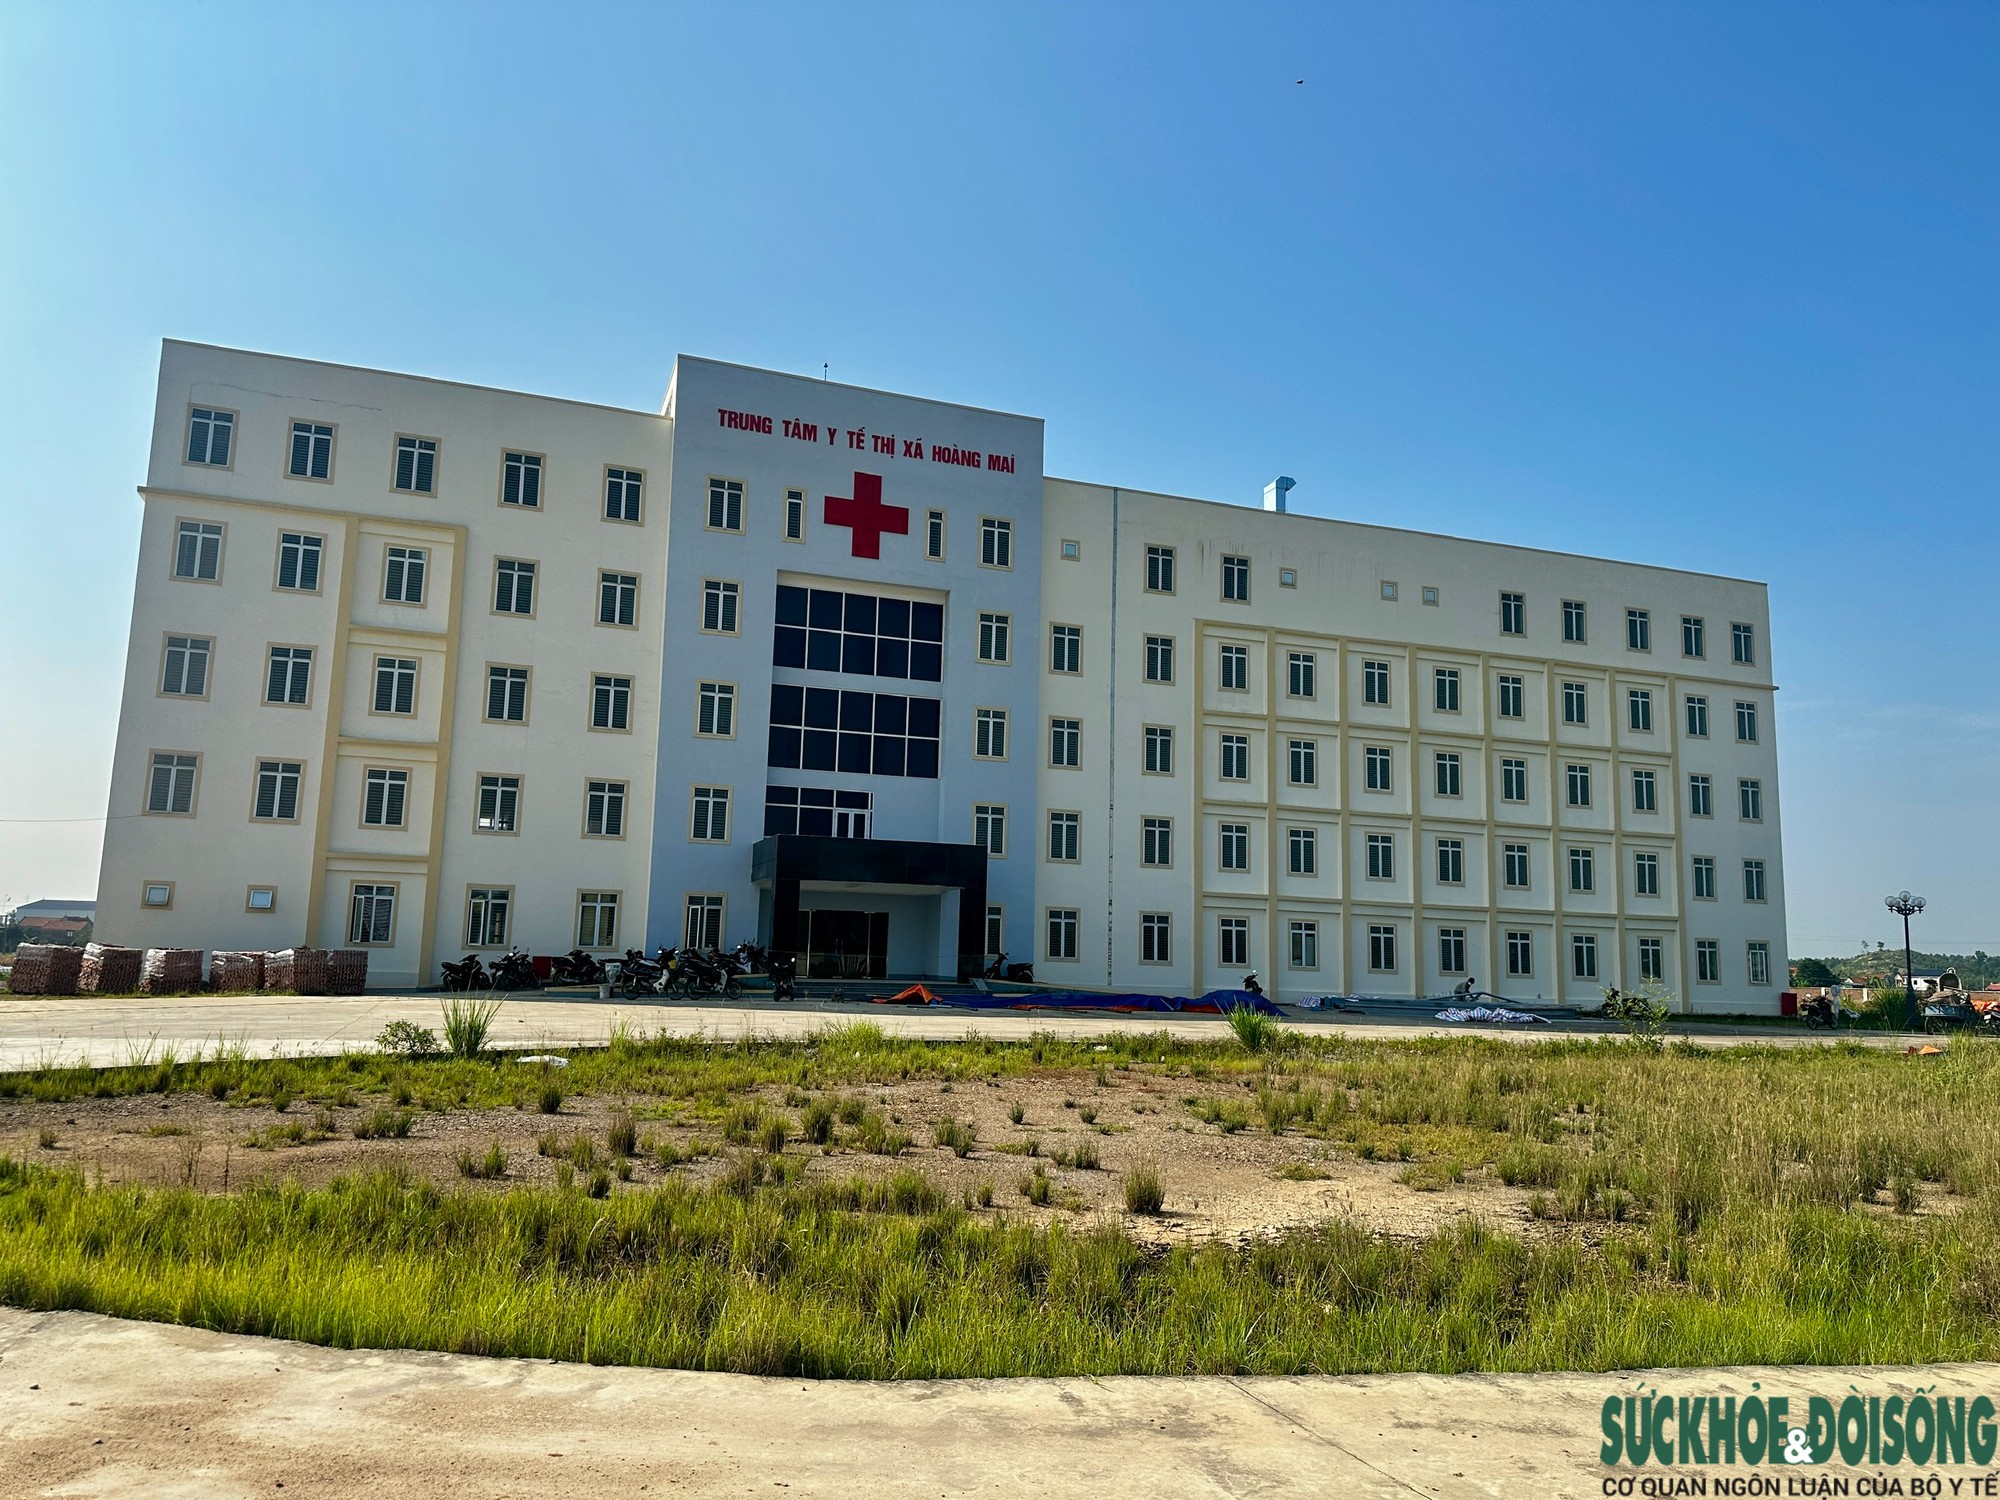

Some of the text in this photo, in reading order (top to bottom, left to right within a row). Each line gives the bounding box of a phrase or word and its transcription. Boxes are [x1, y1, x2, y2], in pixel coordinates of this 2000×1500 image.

[718, 409, 772, 434] TRUNG
[782, 418, 817, 442] TÂM
[827, 427, 837, 445] Y
[847, 426, 865, 450] TẾ
[872, 434, 895, 458] THỊ
[932, 443, 981, 468] HOÀNG
